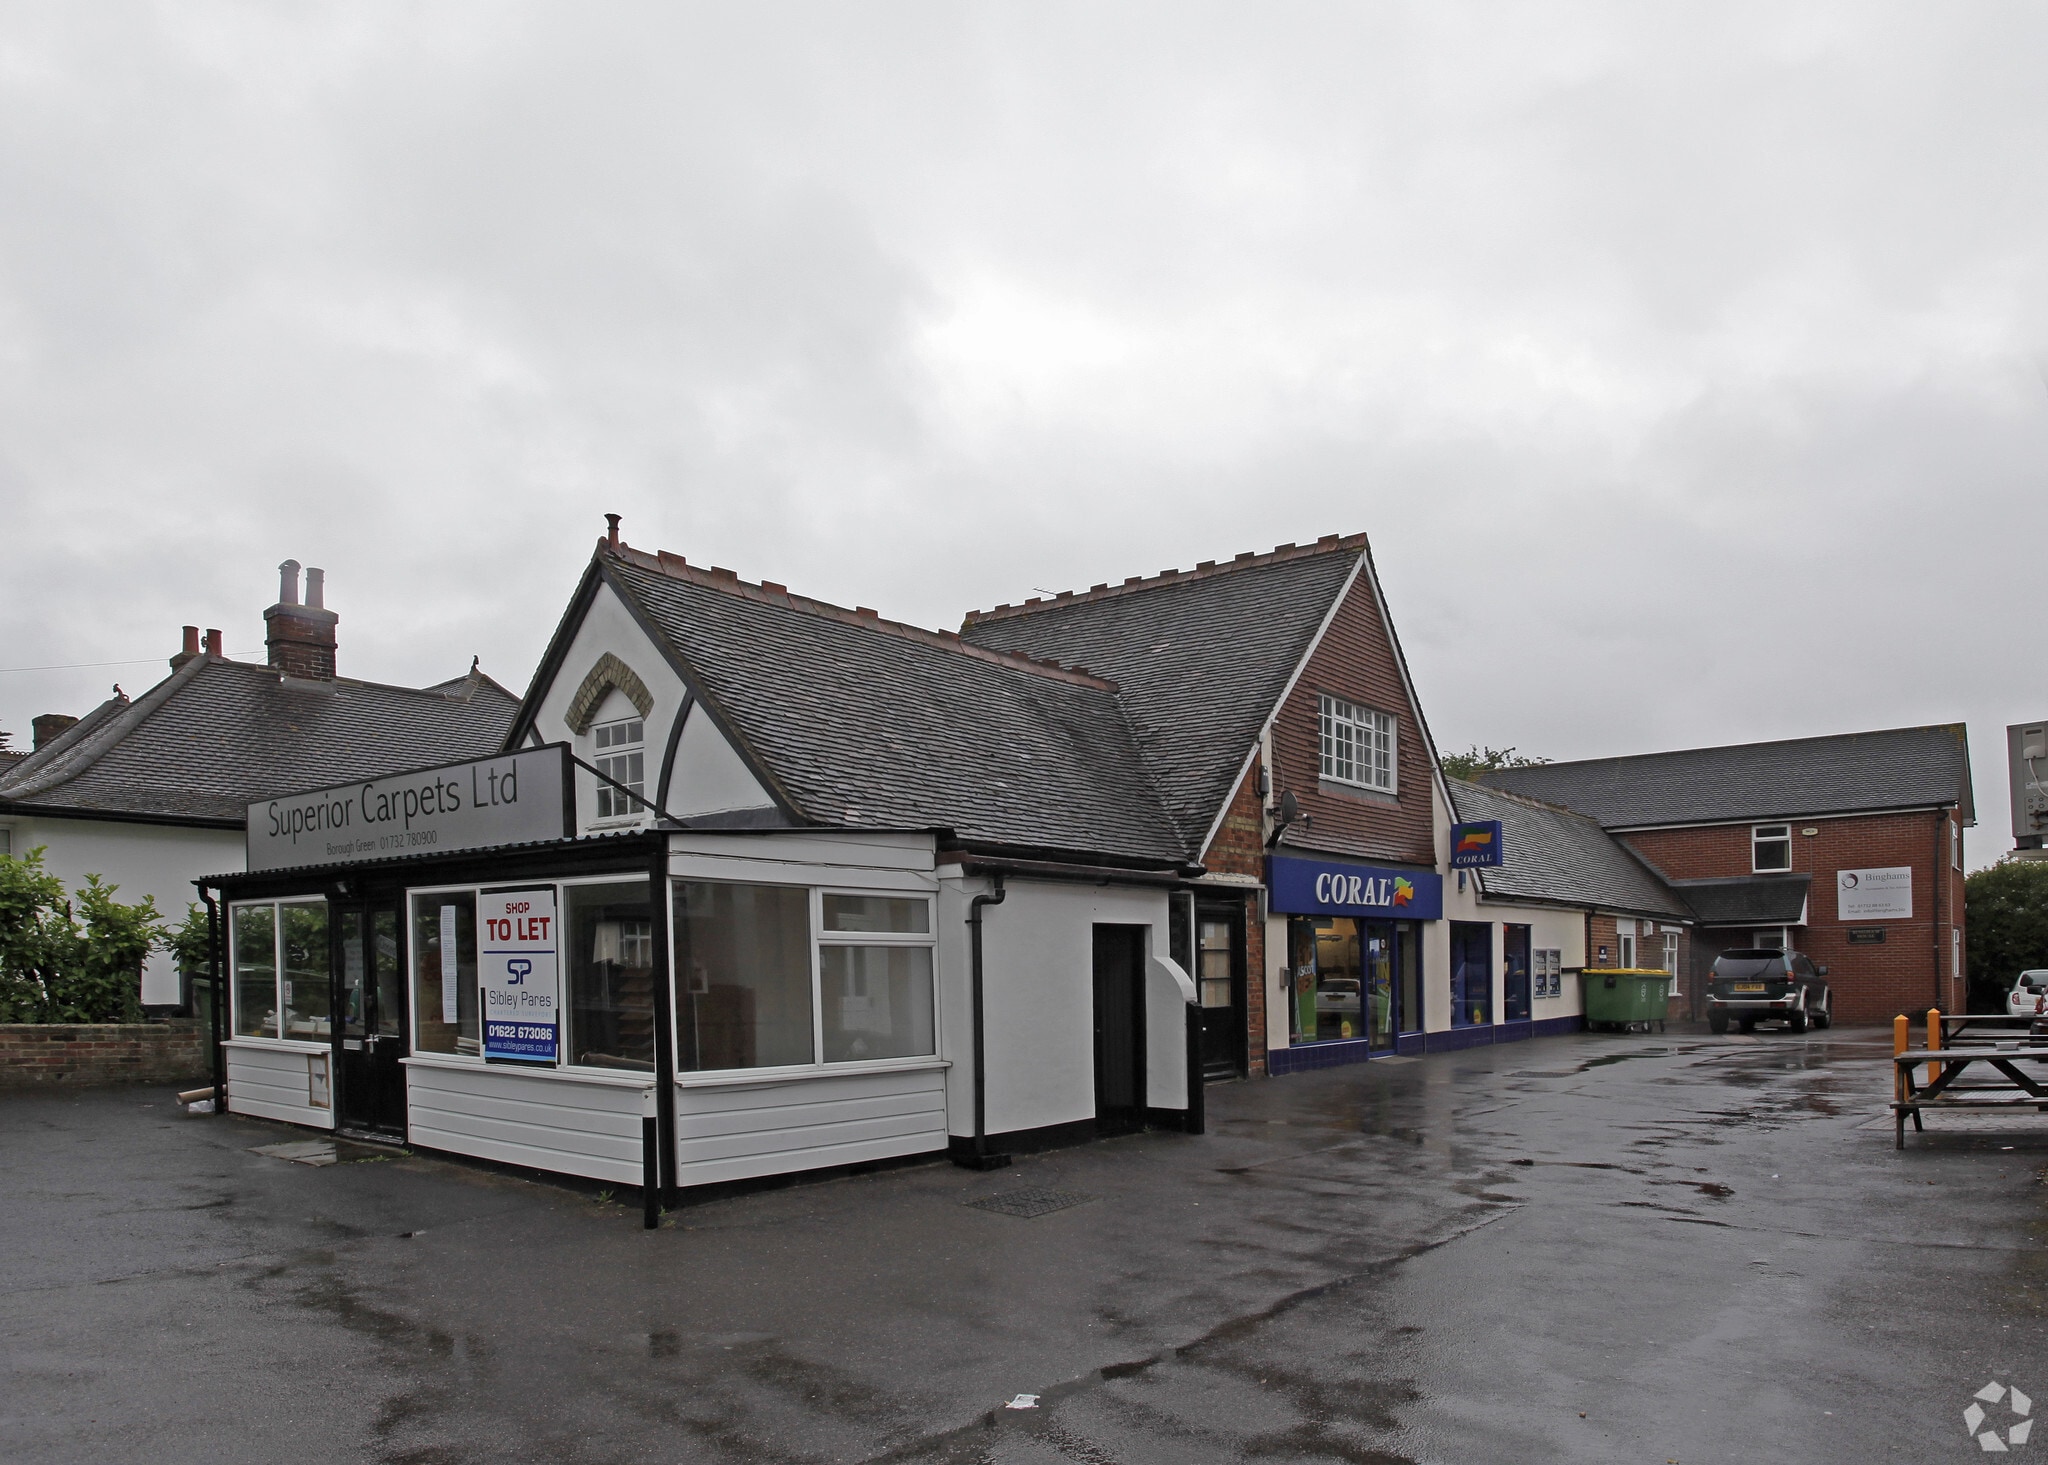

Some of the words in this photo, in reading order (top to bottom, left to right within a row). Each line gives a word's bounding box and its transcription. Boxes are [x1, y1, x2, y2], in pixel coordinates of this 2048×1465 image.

[268, 793, 353, 845] Superior
[361, 776, 461, 830] Carpets
[472, 759, 518, 808] Ltd
[326, 840, 354, 857] Borough
[355, 839, 376, 852] Green
[380, 834, 404, 849] 01732
[407, 830, 438, 847] 780900
[1456, 853, 1493, 865] CORAL
[1865, 872, 1910, 882] Binghams
[1315, 872, 1391, 907] CORAL
[505, 902, 530, 914] SHOP
[486, 918, 511, 941] TO
[517, 917, 551, 941] LET
[489, 990, 518, 1009] Sibley
[521, 991, 552, 1007] Pares
[488, 1025, 516, 1038] 01622
[517, 1026, 553, 1040] 673086
[488, 1041, 552, 1053] www.sibleypares.co.uk
